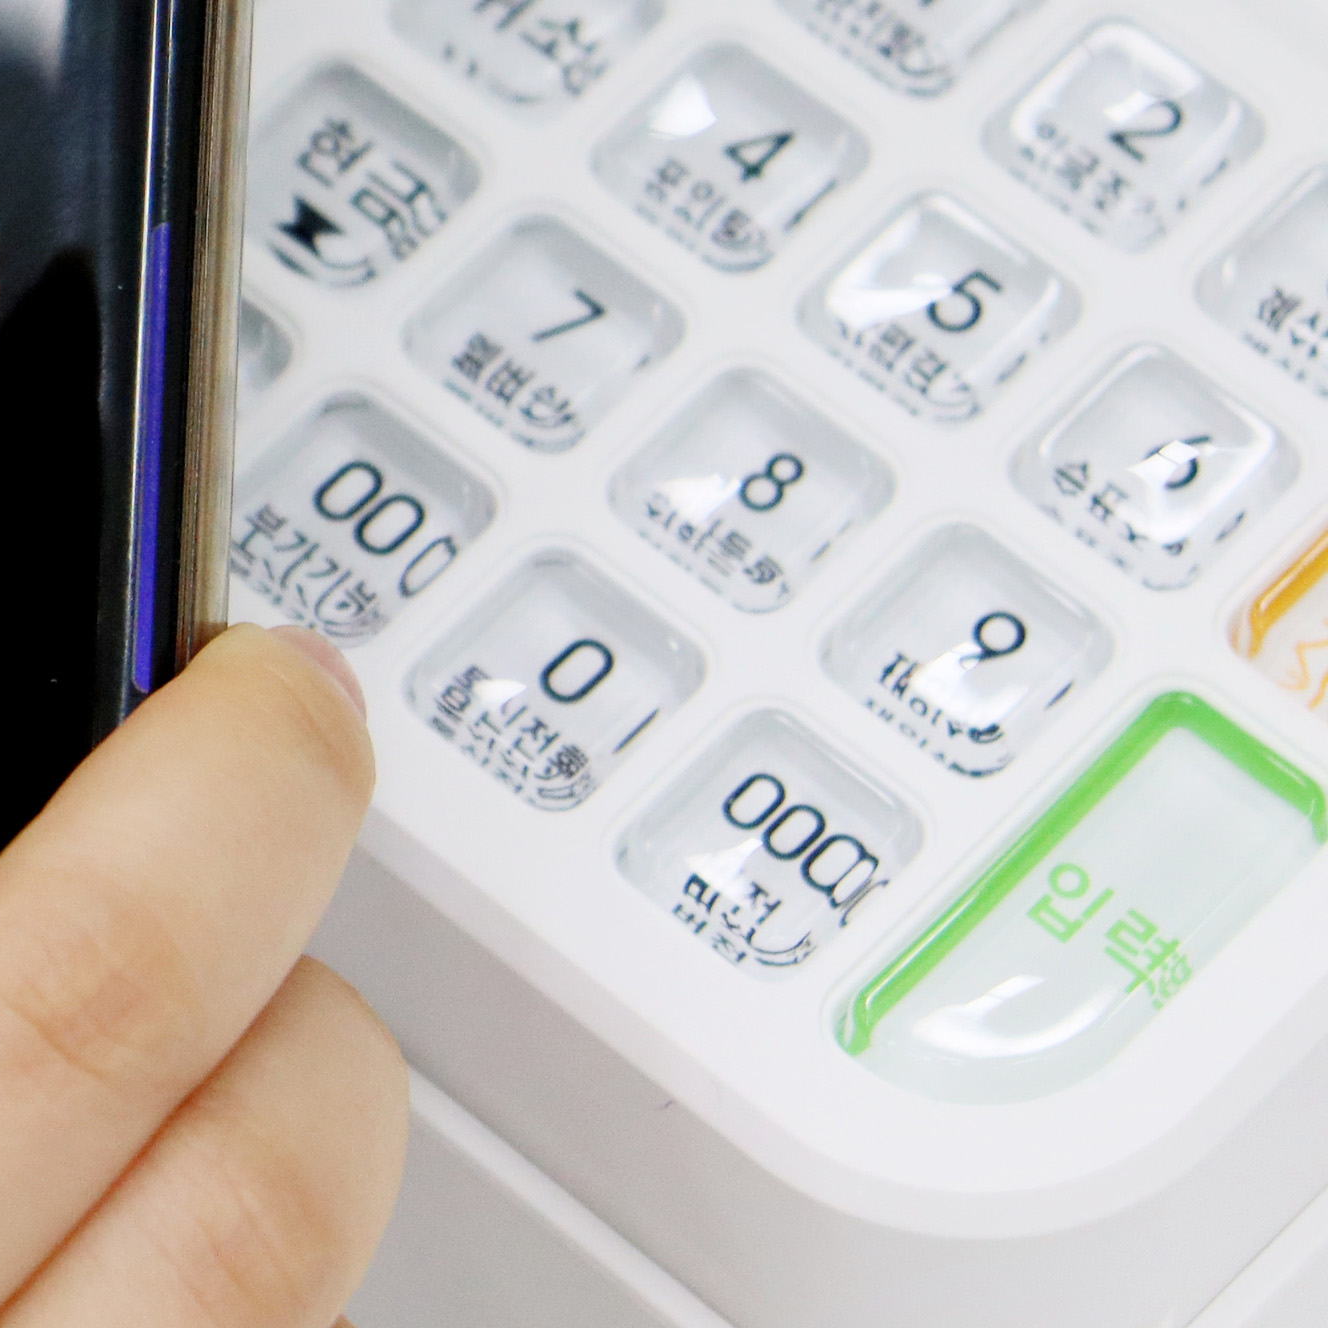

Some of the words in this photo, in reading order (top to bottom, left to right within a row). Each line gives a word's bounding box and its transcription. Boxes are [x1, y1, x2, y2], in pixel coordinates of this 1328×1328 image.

[722, 130, 795, 184] 4
[1107, 97, 1183, 163] 2
[529, 287, 606, 344] 7
[926, 269, 1003, 334] 5
[738, 452, 806, 513] 8
[539, 636, 616, 705] 0
[958, 609, 1027, 671] 9
